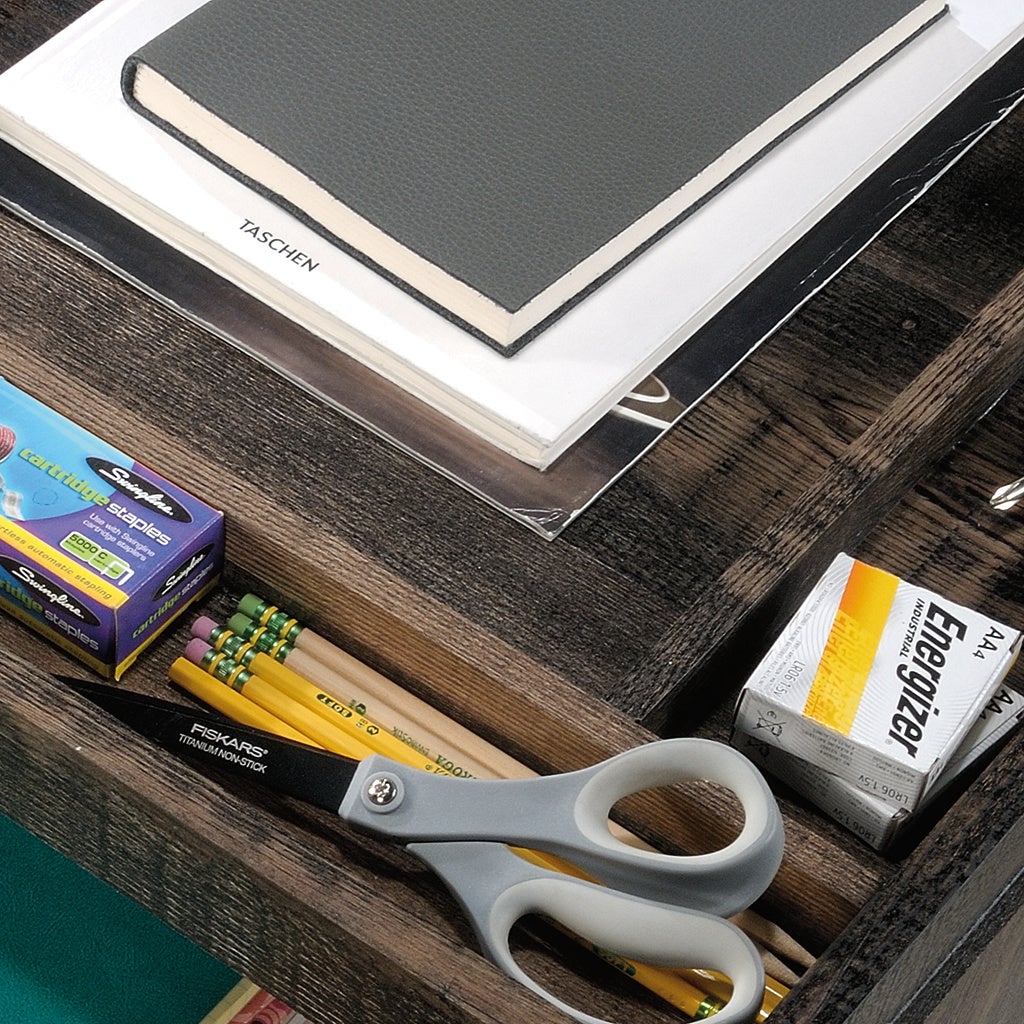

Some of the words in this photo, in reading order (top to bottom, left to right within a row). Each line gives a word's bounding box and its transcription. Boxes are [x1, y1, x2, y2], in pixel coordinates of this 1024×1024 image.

[239, 218, 320, 272] TASCHEN
[19, 447, 110, 507] cartridge
[105, 501, 172, 547] staples
[68, 533, 99, 554] 5000
[82, 519, 118, 543] cartridge
[116, 539, 147, 562] staplers
[89, 512, 106, 526] Use
[105, 522, 122, 537] with
[120, 532, 156, 558] Swingline
[97, 551, 109, 561] C
[26, 543, 74, 576] automatic
[74, 573, 114, 601] stapling
[44, 608, 100, 652] staples
[132, 592, 182, 639] cartridge
[899, 597, 926, 659] INDUSTRIAL
[784, 660, 807, 682] LR06
[888, 601, 969, 759] Energizer
[178, 733, 220, 756] TITANIUM
[217, 748, 269, 774] NON-STICK
[189, 722, 265, 759] FISKARS
[881, 784, 909, 805] LR06
